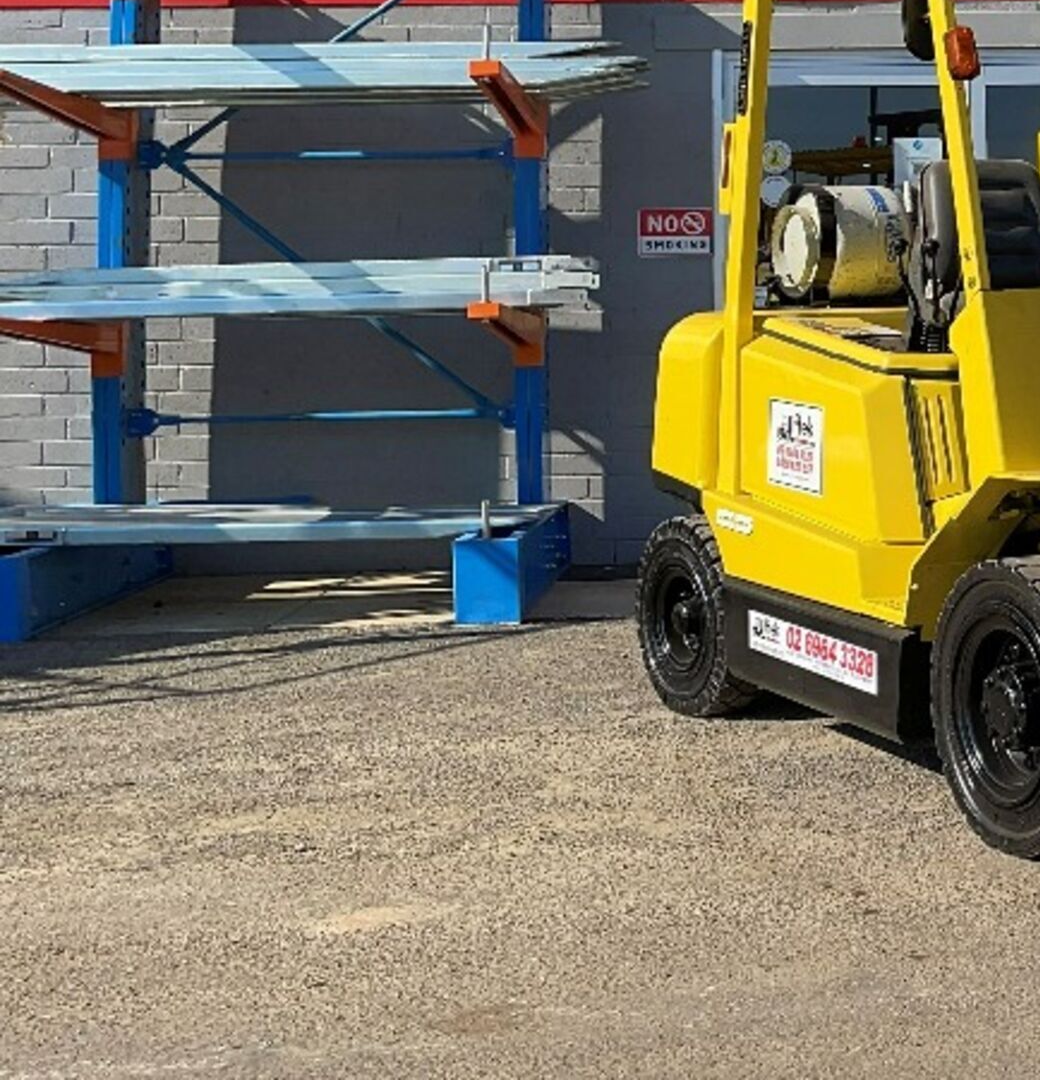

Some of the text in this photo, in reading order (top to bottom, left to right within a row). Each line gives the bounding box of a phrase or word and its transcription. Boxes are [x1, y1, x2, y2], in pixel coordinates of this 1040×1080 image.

[647, 214, 678, 232] NO
[645, 240, 707, 250] SMOKING
[786, 627, 802, 651] 02
[839, 643, 874, 678] 3328
